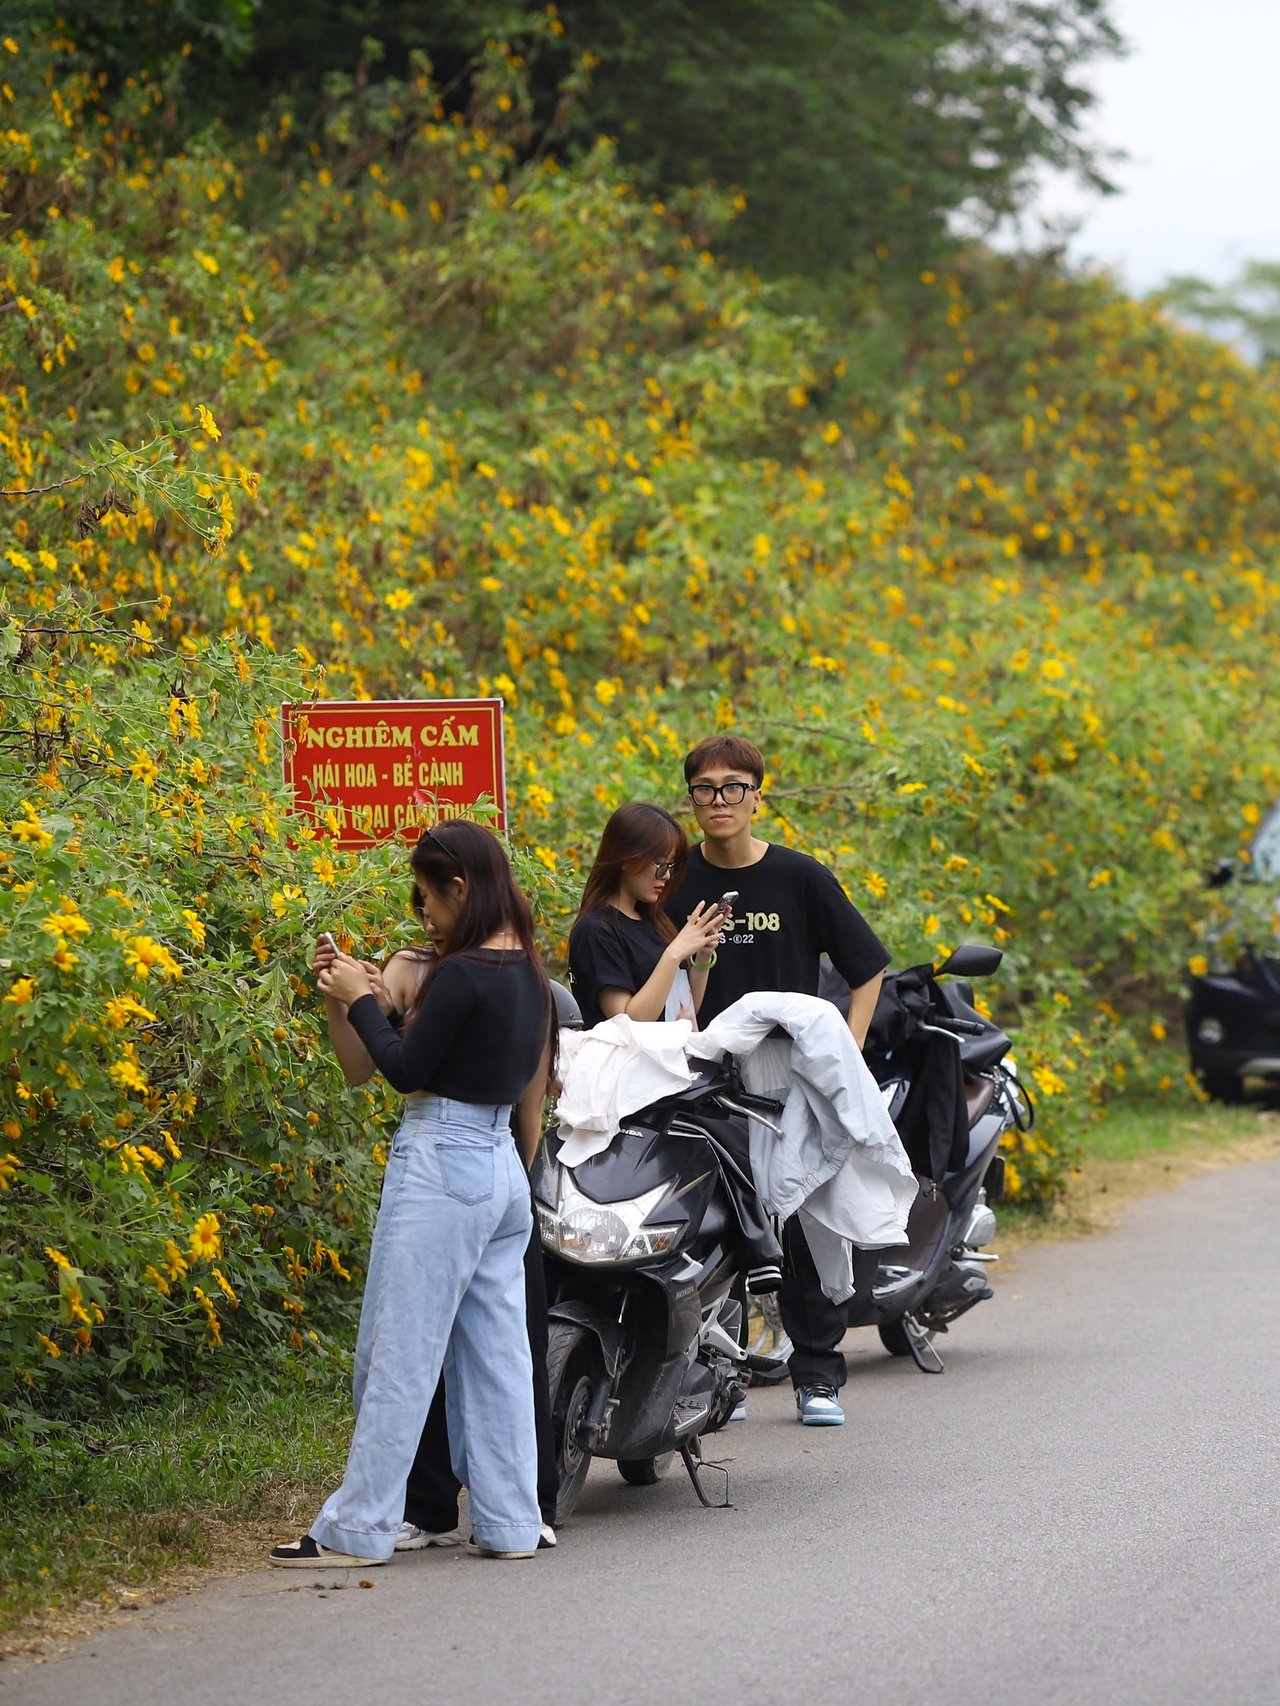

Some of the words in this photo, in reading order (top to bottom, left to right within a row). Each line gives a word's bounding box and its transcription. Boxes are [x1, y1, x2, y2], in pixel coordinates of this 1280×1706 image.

[306, 720, 412, 748] NGHIÊM
[420, 715, 480, 747] CẤM
[312, 758, 340, 788] HÁI
[345, 763, 378, 787] HOA
[393, 754, 414, 787] BẺ
[418, 757, 464, 786] CÀNH
